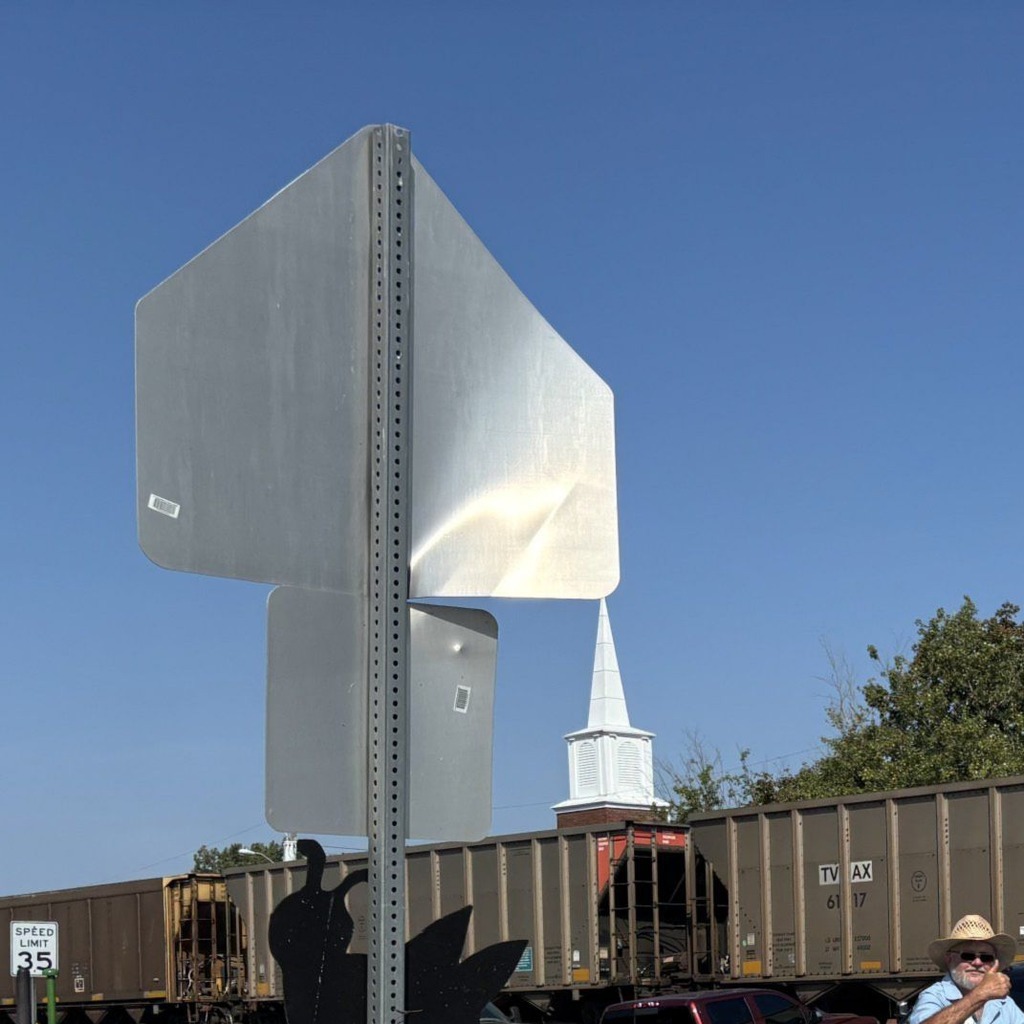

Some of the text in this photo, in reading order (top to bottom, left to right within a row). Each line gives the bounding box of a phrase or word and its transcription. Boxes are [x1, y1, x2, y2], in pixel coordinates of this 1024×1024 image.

[853, 892, 867, 908] 17
[15, 927, 54, 936] SPEED
[20, 939, 49, 948] LIMIT
[17, 951, 53, 970] 35
